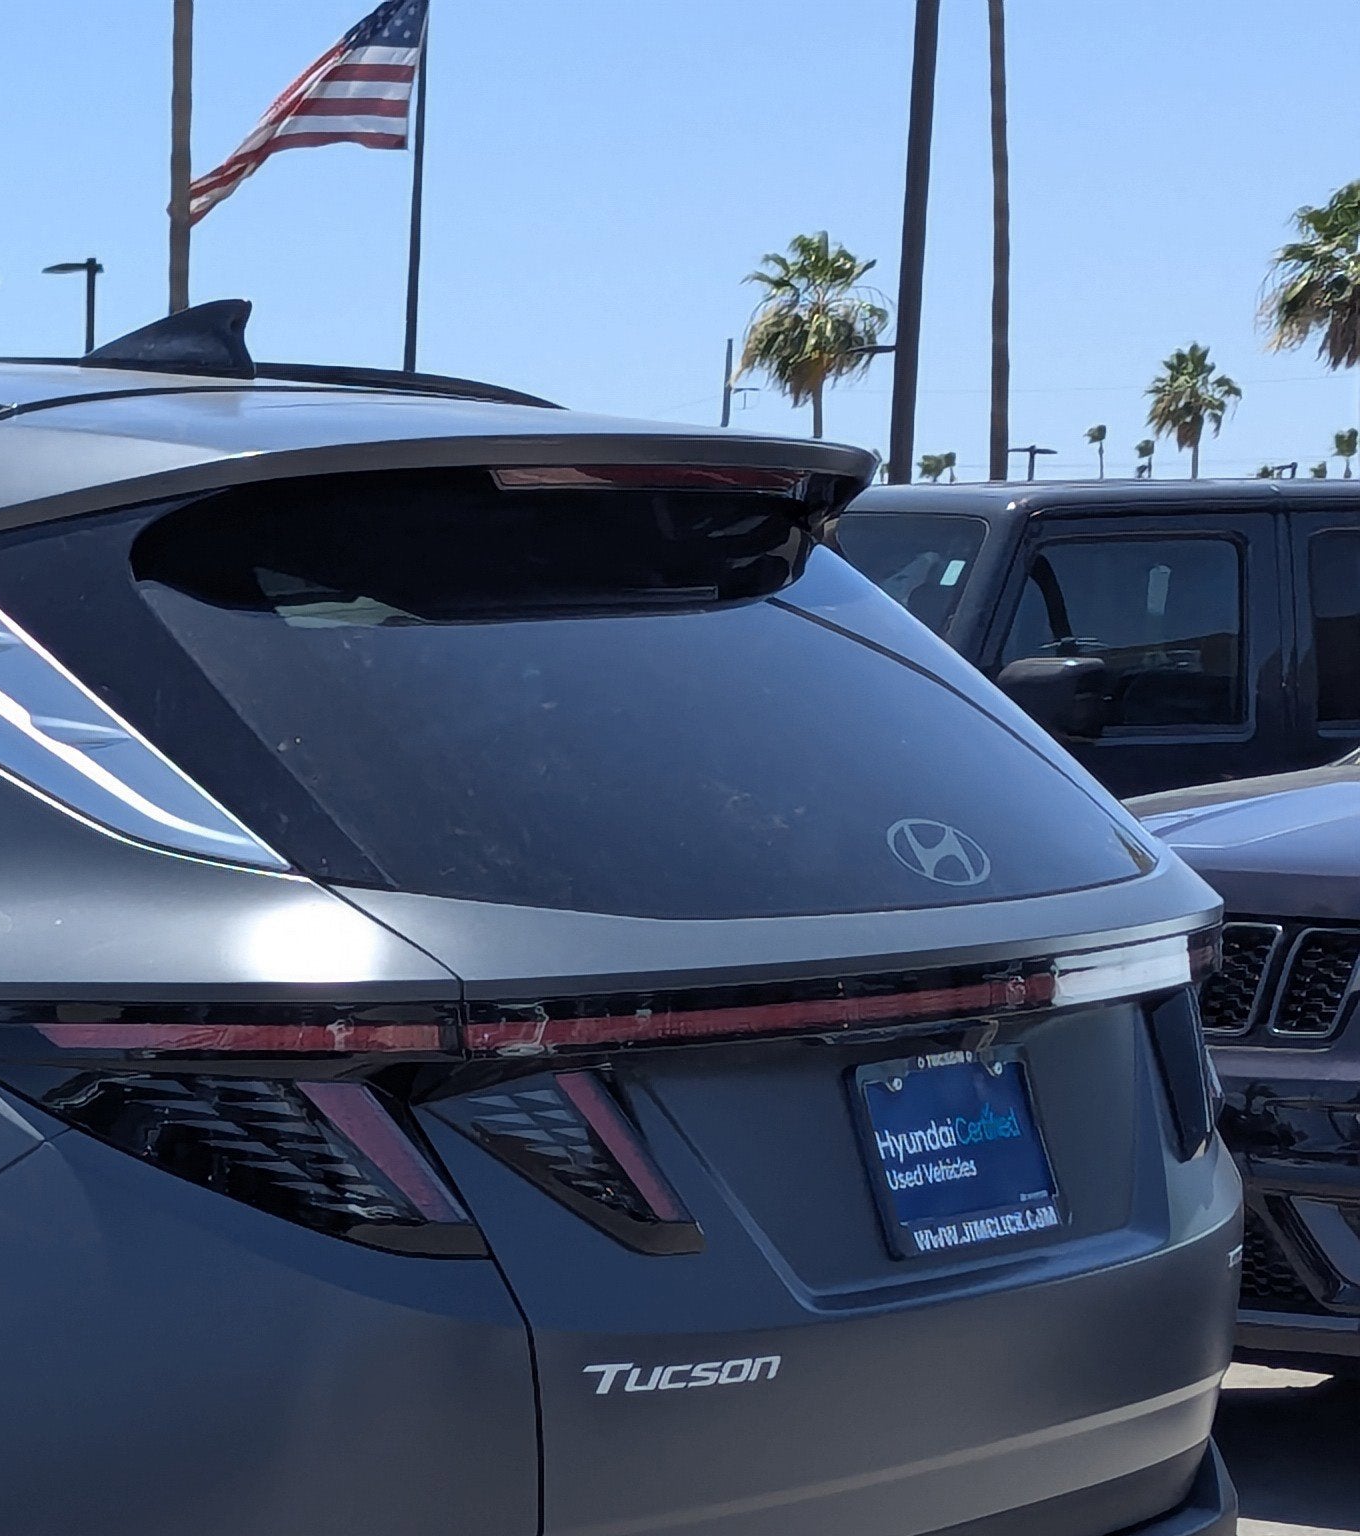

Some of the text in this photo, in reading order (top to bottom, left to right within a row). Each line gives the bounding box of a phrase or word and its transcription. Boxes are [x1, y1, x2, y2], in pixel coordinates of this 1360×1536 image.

[874, 1117, 957, 1164] Hyundai
[885, 1156, 978, 1191] Used Vehicles
